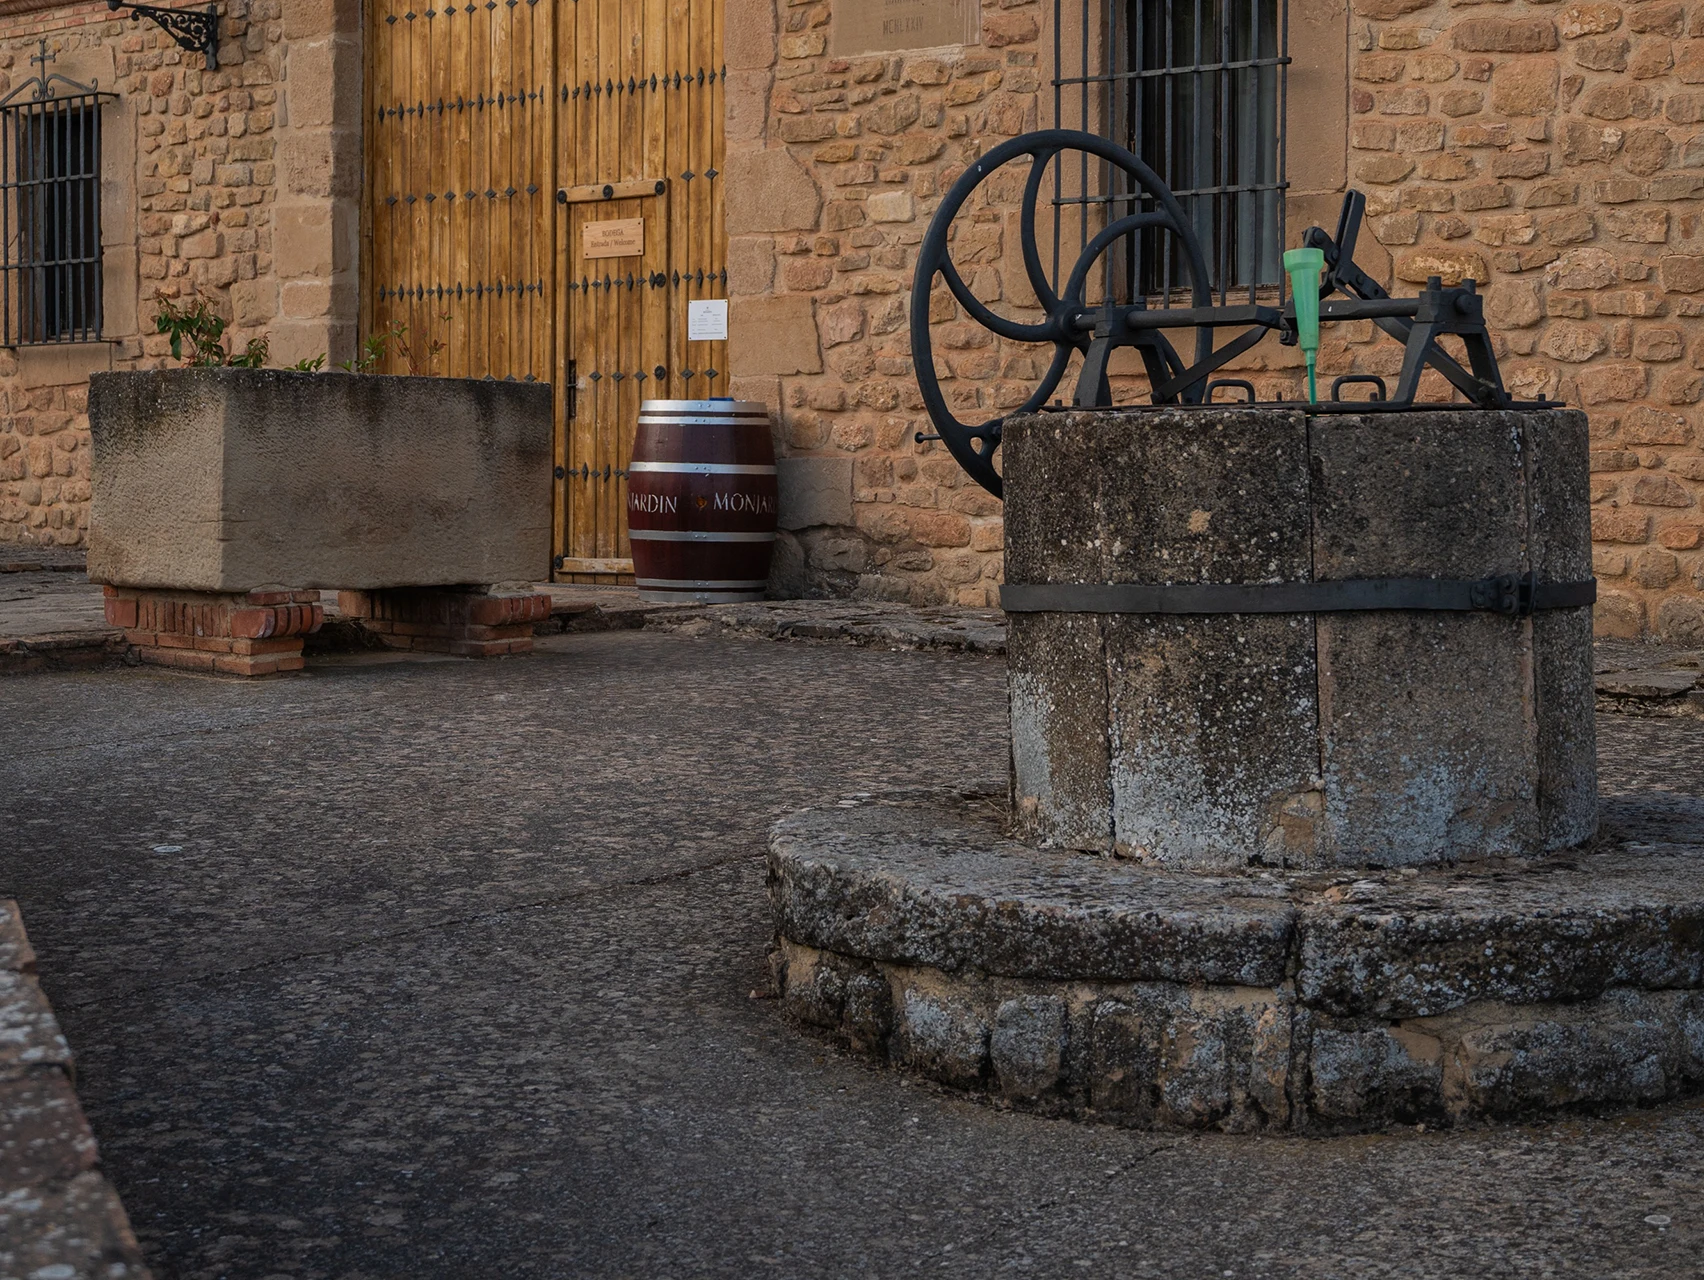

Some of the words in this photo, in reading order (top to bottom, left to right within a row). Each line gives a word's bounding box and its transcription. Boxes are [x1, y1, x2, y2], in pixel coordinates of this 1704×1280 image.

[602, 228, 625, 237] BODEGA
[590, 239, 610, 248] Entrada
[613, 238, 636, 246] Welcome
